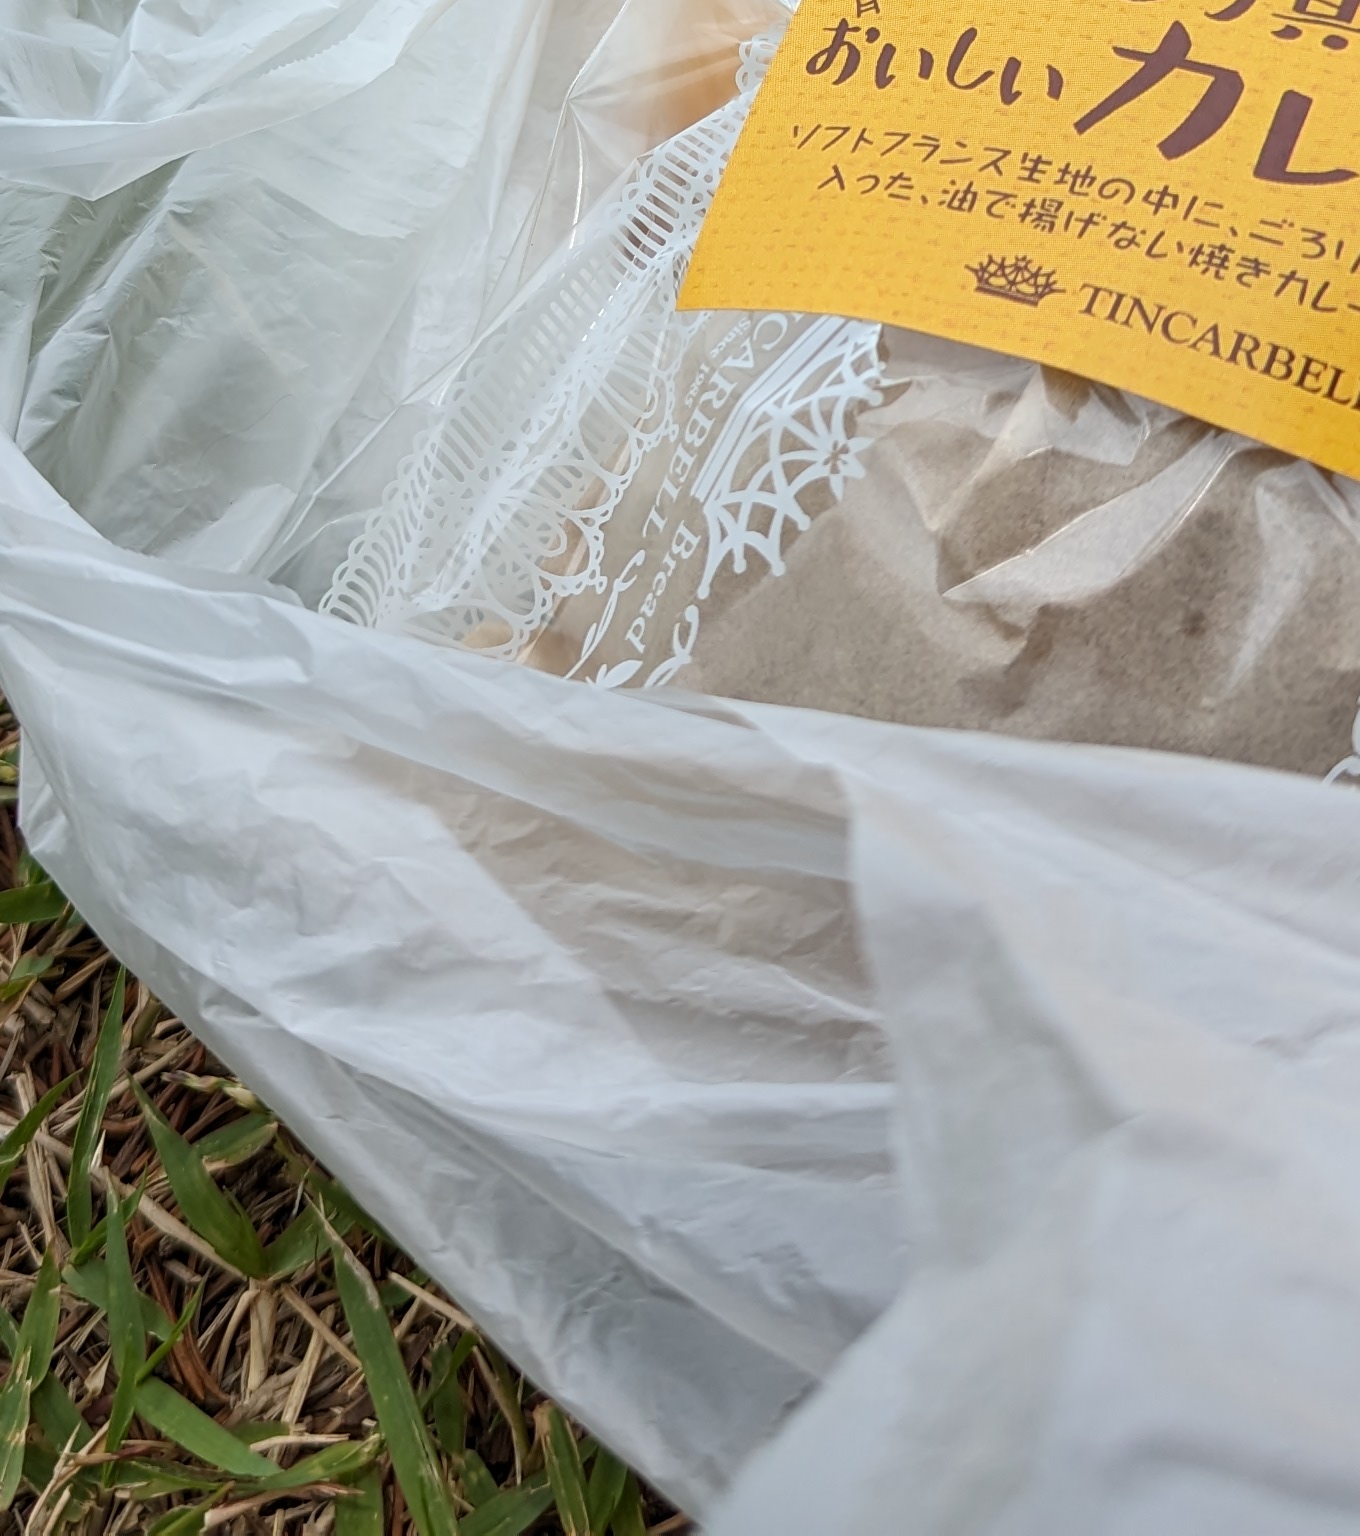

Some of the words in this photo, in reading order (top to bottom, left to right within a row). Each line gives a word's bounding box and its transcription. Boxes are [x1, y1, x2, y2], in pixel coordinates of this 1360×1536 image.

[709, 315, 753, 359] Since
[642, 312, 800, 539] CARBELL
[625, 519, 702, 655] Bread
